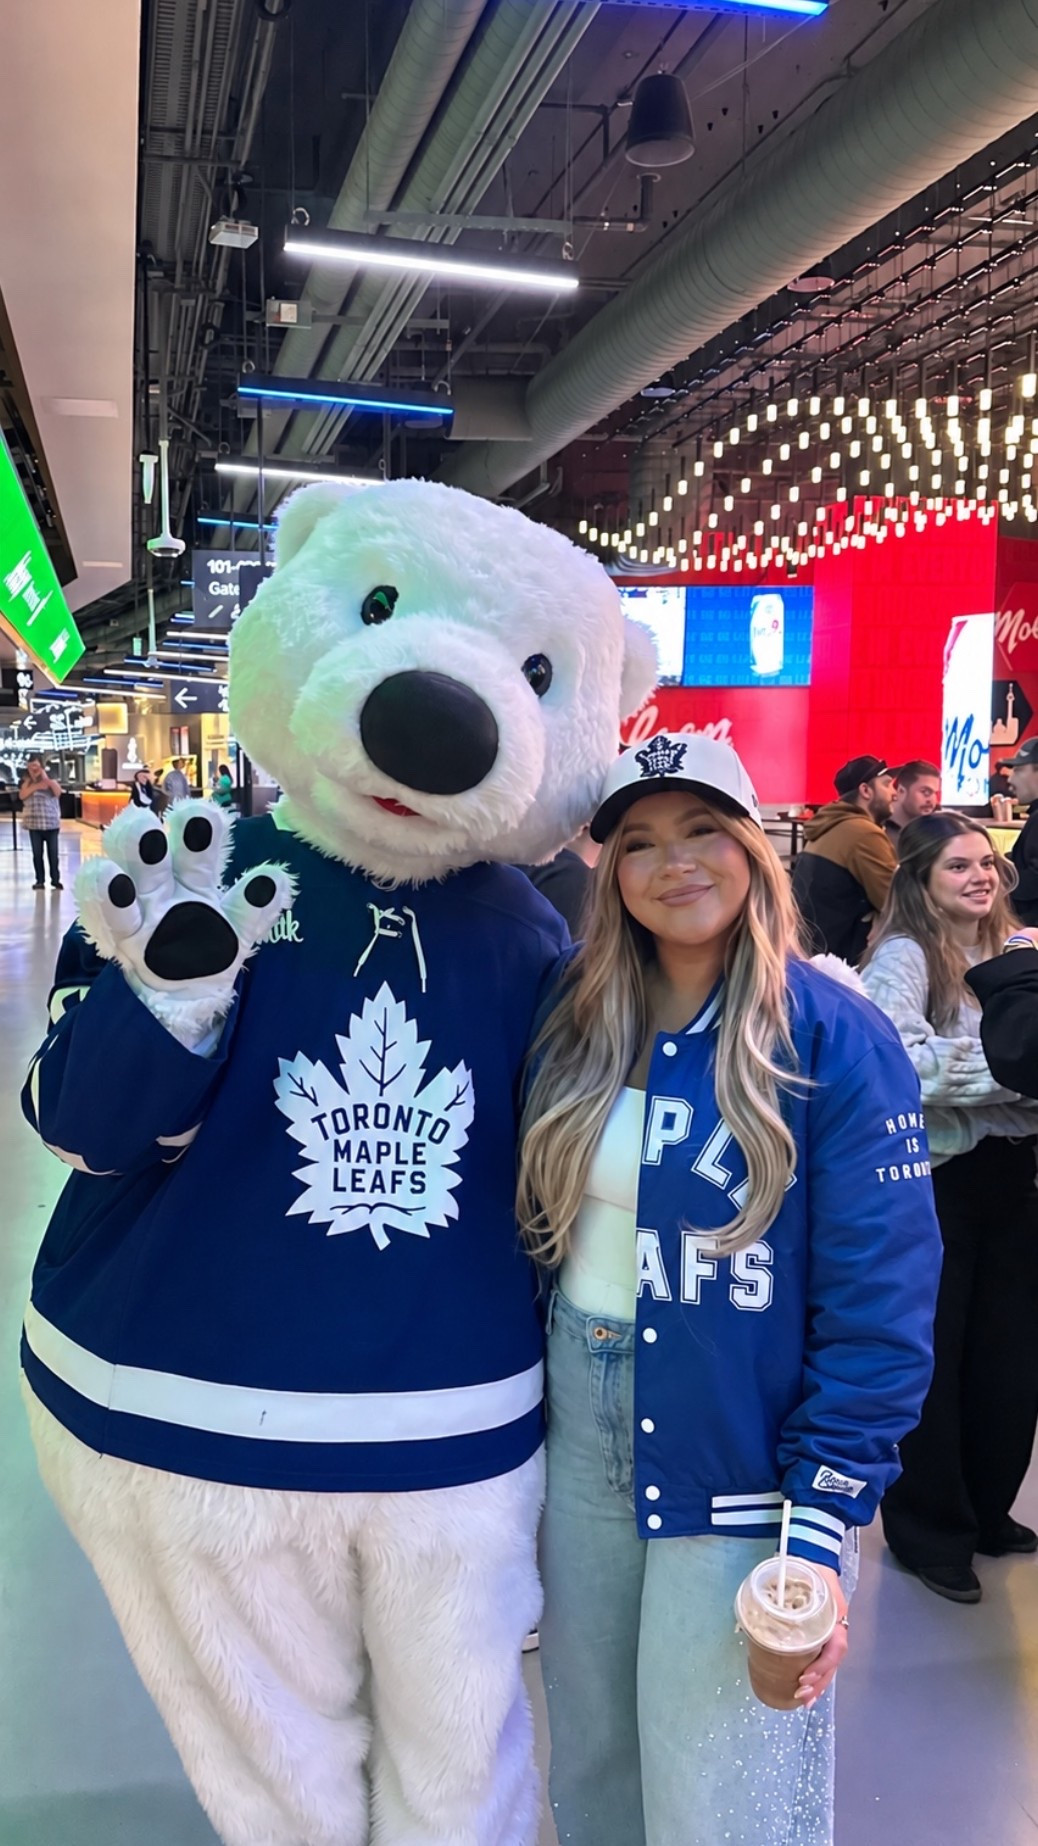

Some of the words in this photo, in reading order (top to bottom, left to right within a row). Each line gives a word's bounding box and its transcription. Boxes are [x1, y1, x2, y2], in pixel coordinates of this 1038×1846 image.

[311, 1102, 450, 1145] TORONTO
[885, 1112, 925, 1135] HOME
[333, 1138, 427, 1165] MAPLE
[905, 1136, 920, 1154] IS
[332, 1167, 427, 1195] LEAFS
